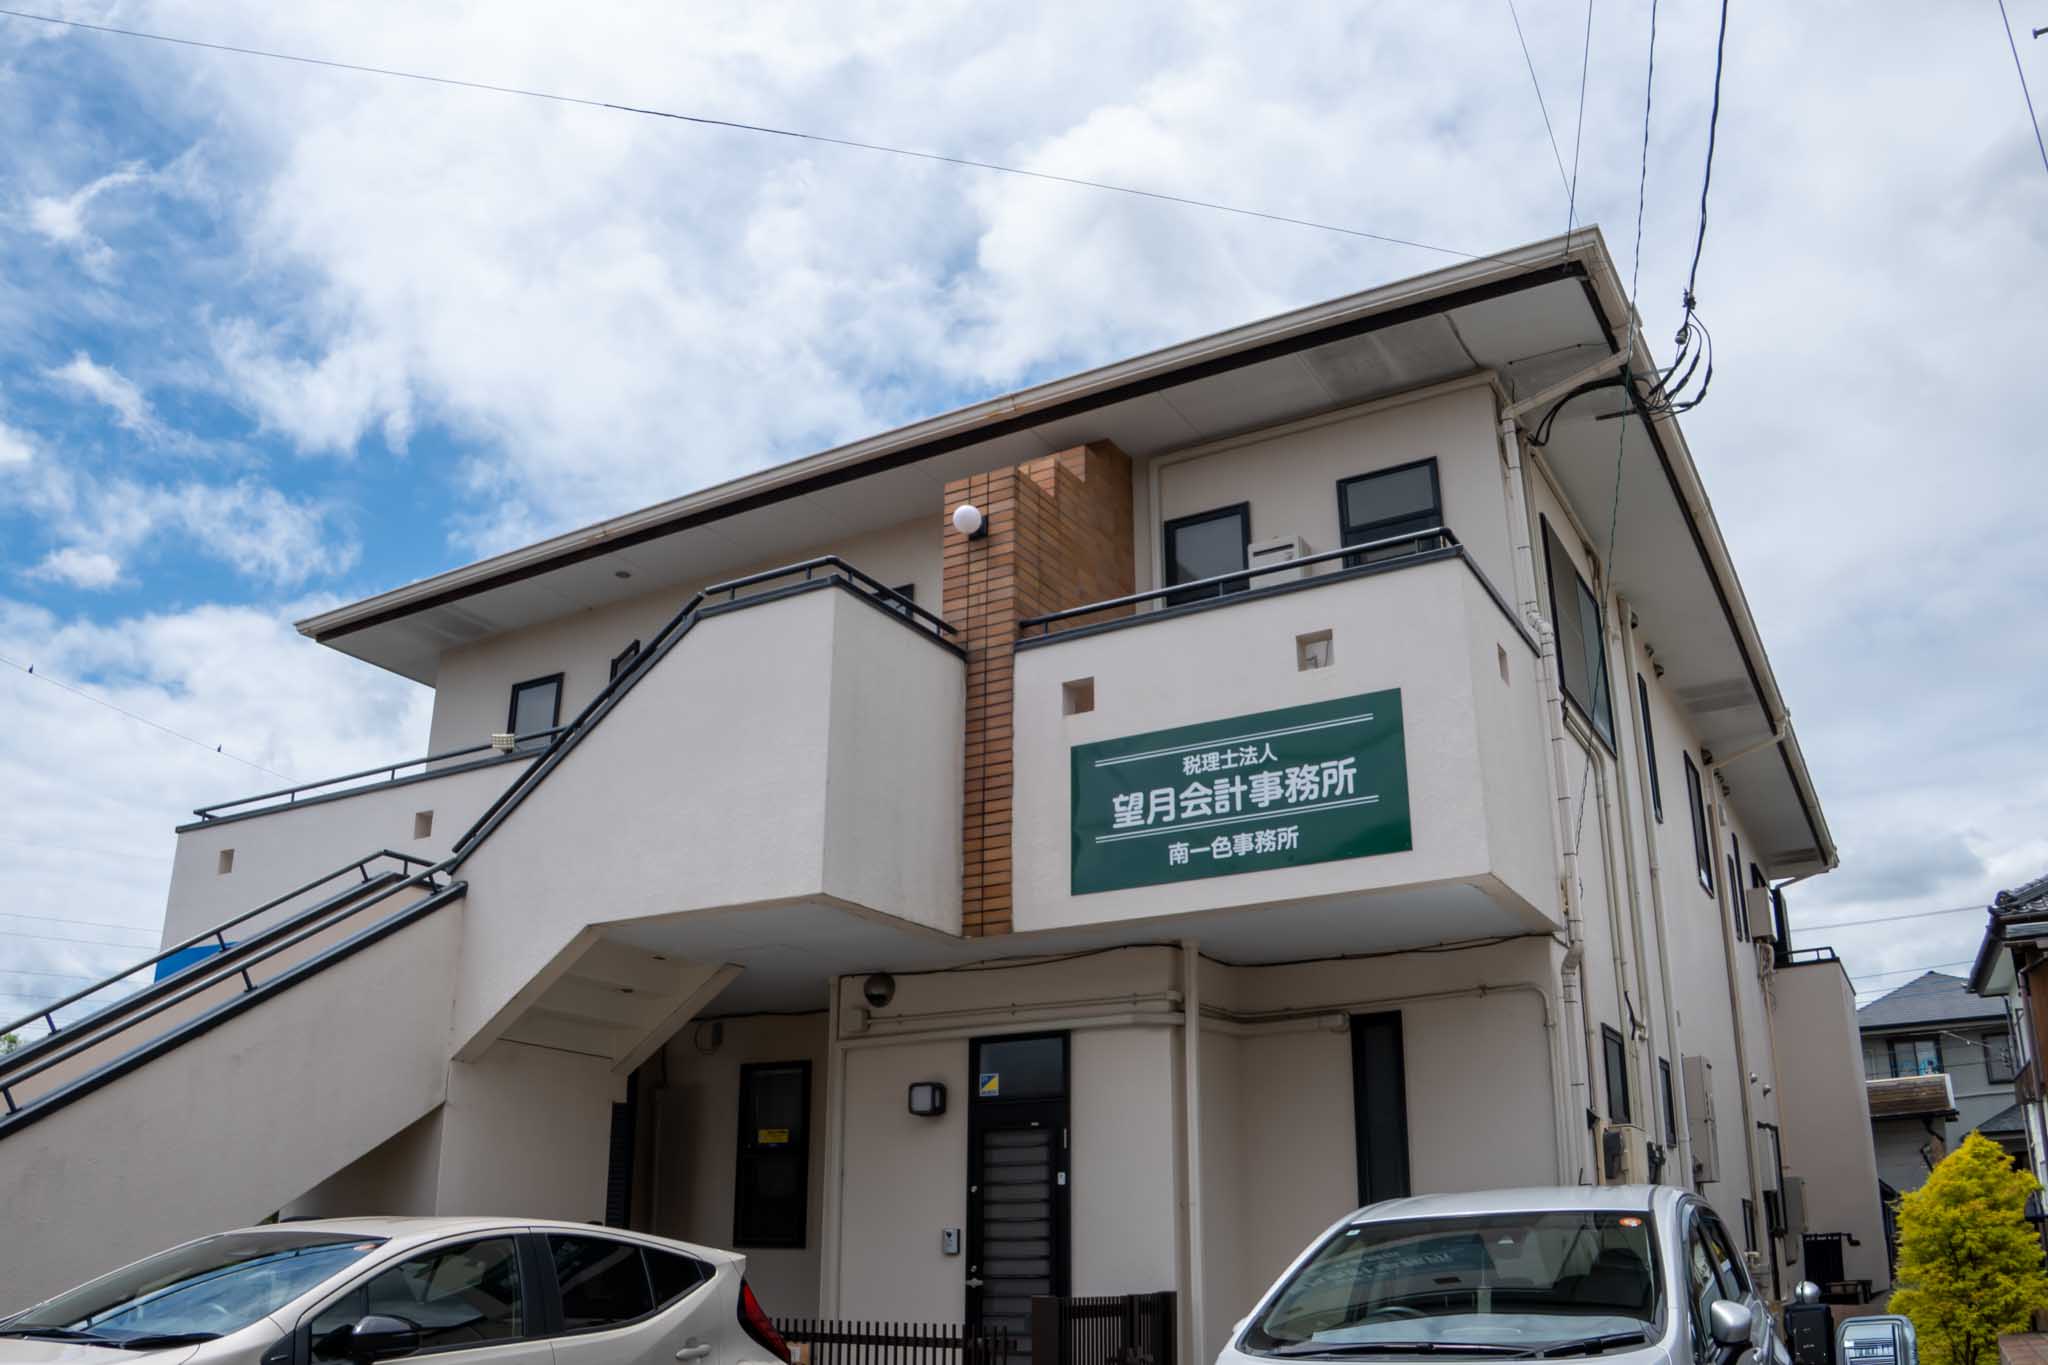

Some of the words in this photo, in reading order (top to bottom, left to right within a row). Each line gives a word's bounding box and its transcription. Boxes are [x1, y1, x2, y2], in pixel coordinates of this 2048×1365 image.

[1182, 742, 1279, 776] 税理士法人
[1112, 757, 1357, 829] 望月会計事務所
[1168, 825, 1300, 866] 南一色事務所
